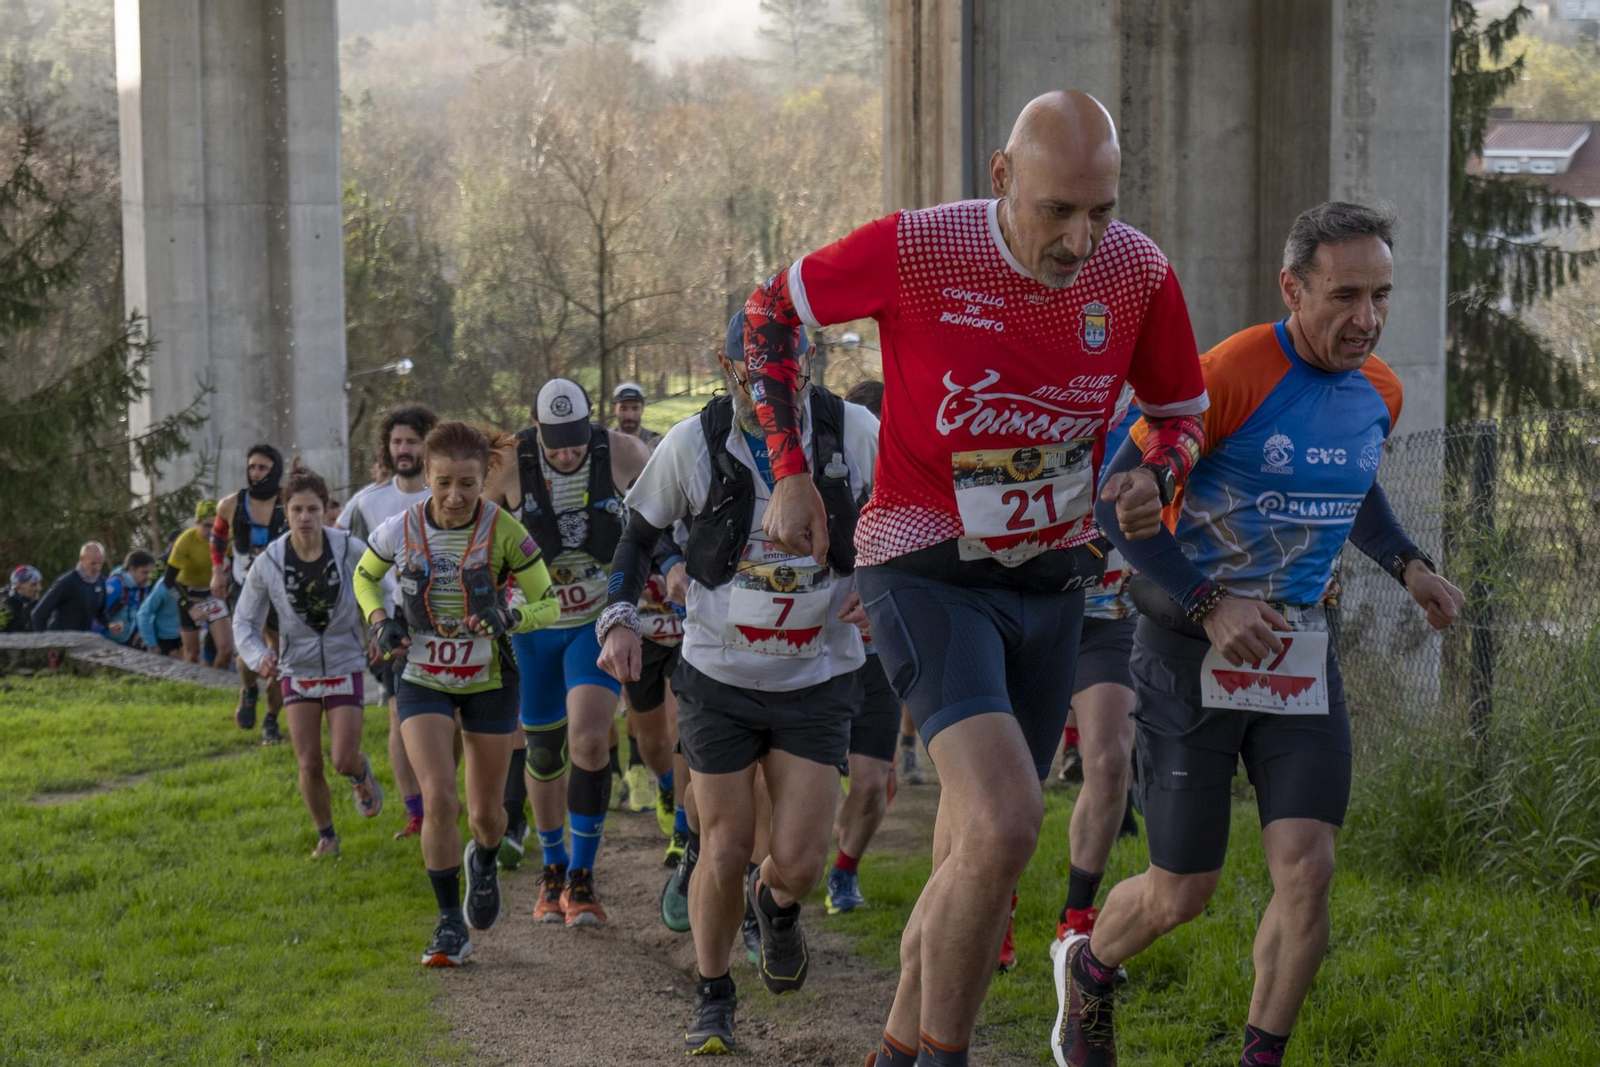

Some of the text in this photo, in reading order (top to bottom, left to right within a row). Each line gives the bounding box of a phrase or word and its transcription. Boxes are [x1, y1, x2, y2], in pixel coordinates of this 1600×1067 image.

[942, 287, 1005, 307] CONCELLO
[965, 304, 982, 315] DE
[939, 311, 1004, 332] BOIMORTO
[1068, 374, 1118, 389] CLUBE
[1028, 385, 1109, 403] ATLETISMO
[1001, 484, 1057, 531] 21
[556, 586, 586, 607] 10
[772, 597, 795, 627] 7
[425, 640, 474, 665] 107
